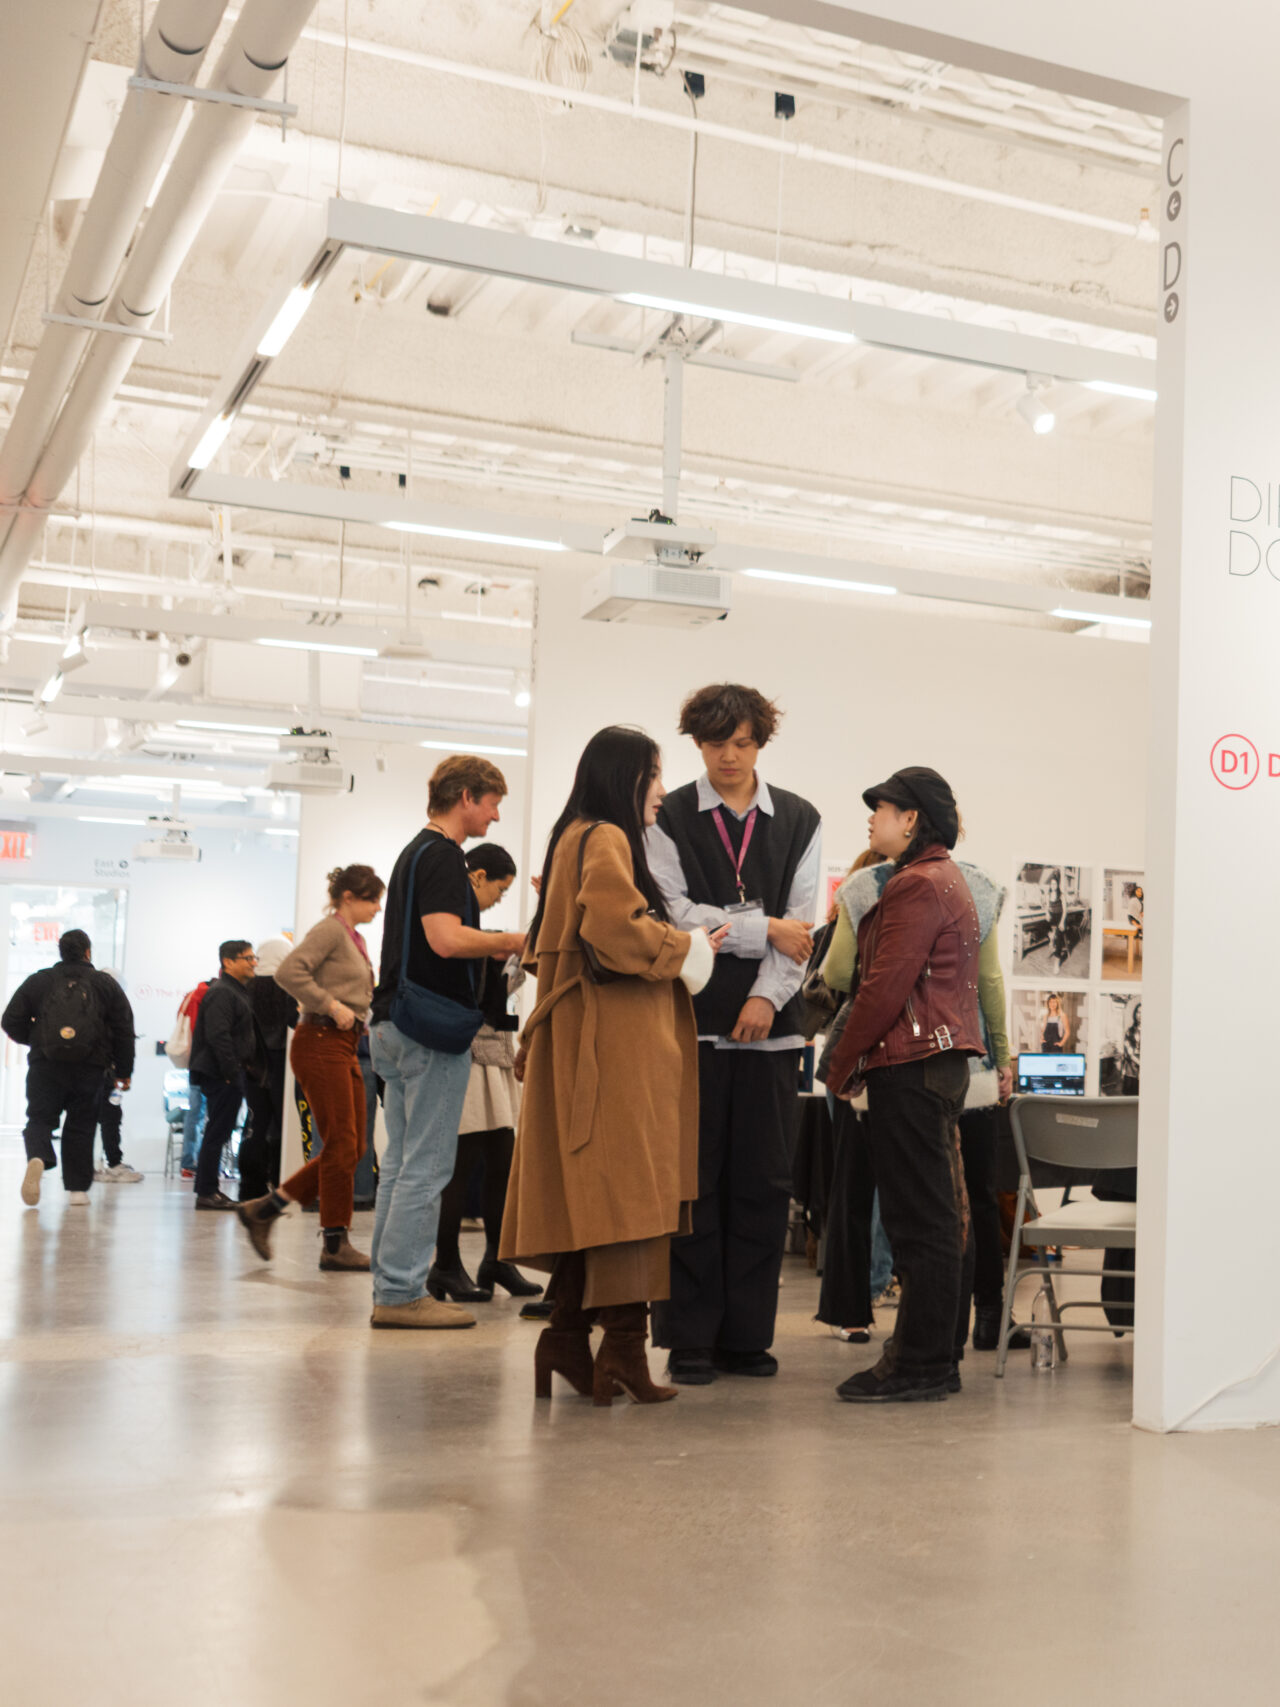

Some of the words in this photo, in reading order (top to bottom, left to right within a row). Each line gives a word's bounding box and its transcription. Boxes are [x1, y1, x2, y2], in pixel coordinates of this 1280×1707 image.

[1166, 138, 1184, 187] C
[1163, 242, 1181, 291] D
[1221, 749, 1249, 775] D1
